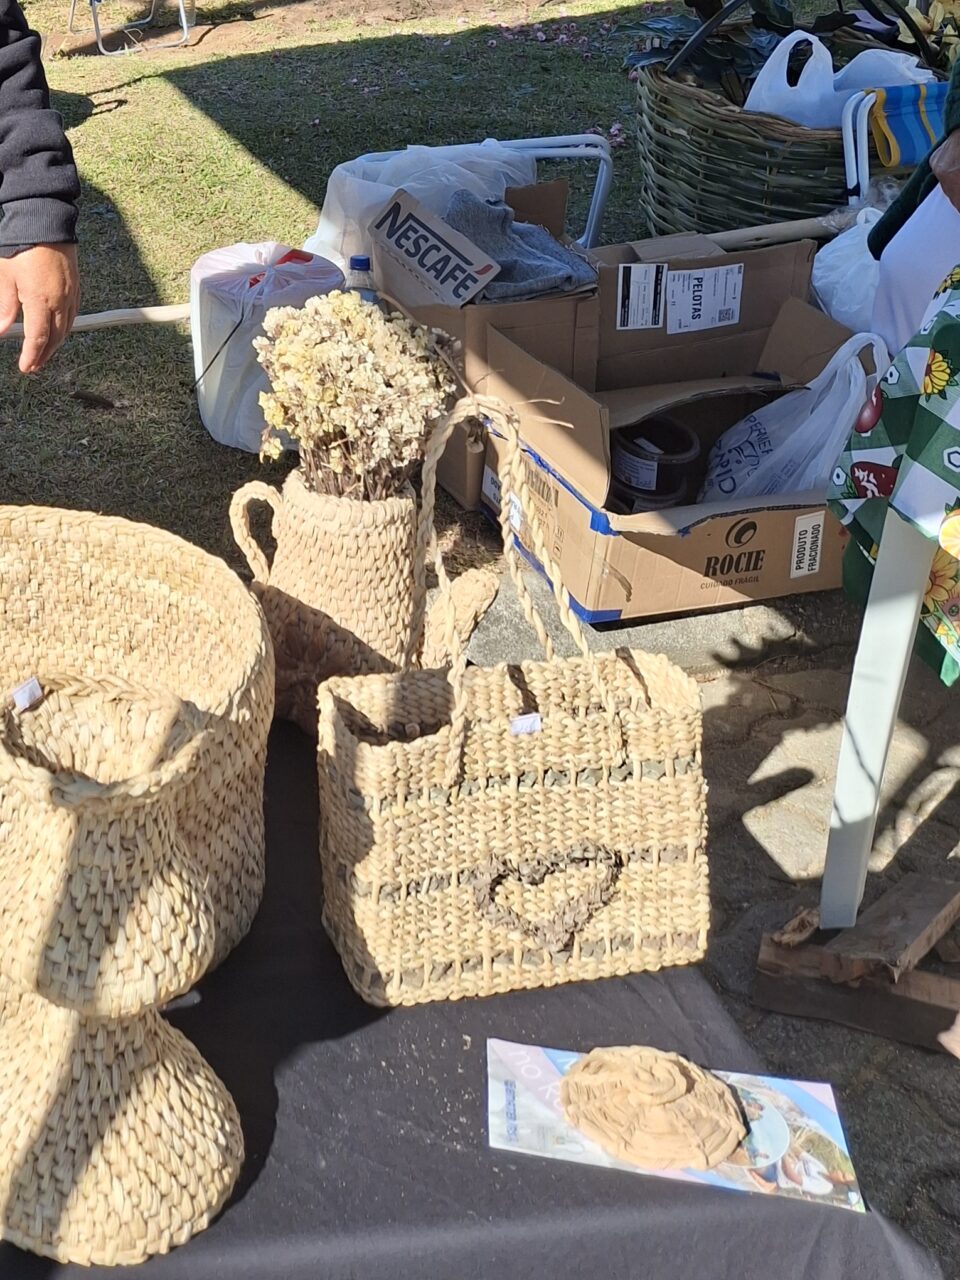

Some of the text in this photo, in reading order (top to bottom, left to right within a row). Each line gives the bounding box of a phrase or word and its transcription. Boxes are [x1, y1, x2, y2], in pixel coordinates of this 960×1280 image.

[691, 277, 704, 320] PELOTAS
[703, 549, 766, 577] ROCIE
[795, 529, 808, 571] PRODUTO
[808, 523, 821, 572] FRACIONADO
